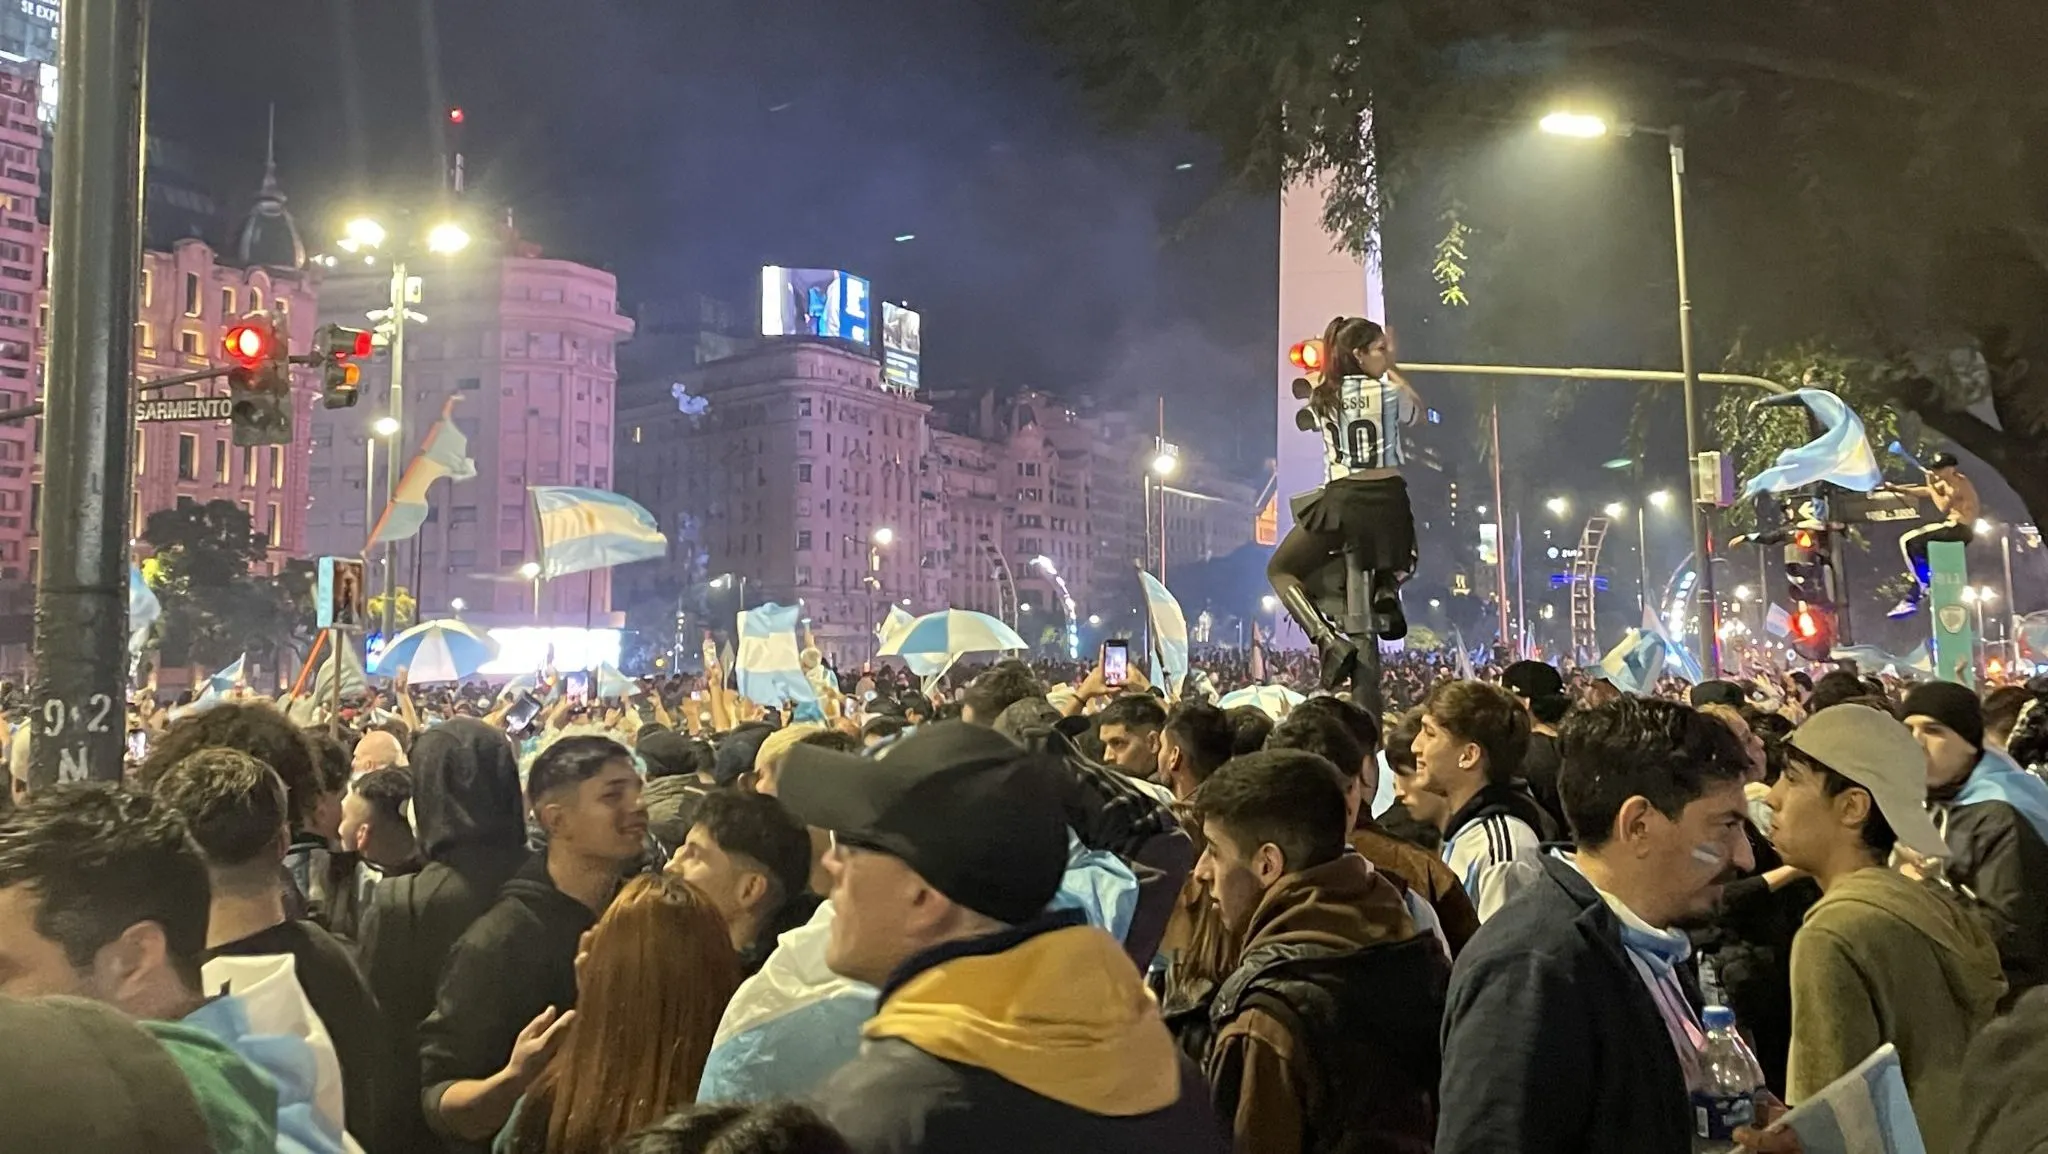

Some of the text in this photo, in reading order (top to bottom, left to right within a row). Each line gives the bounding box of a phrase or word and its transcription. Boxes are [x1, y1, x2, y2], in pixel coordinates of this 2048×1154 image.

[136, 399, 232, 421] SARMIENTO
[1341, 395, 1370, 410] ESSI
[1326, 419, 1377, 469] 10
